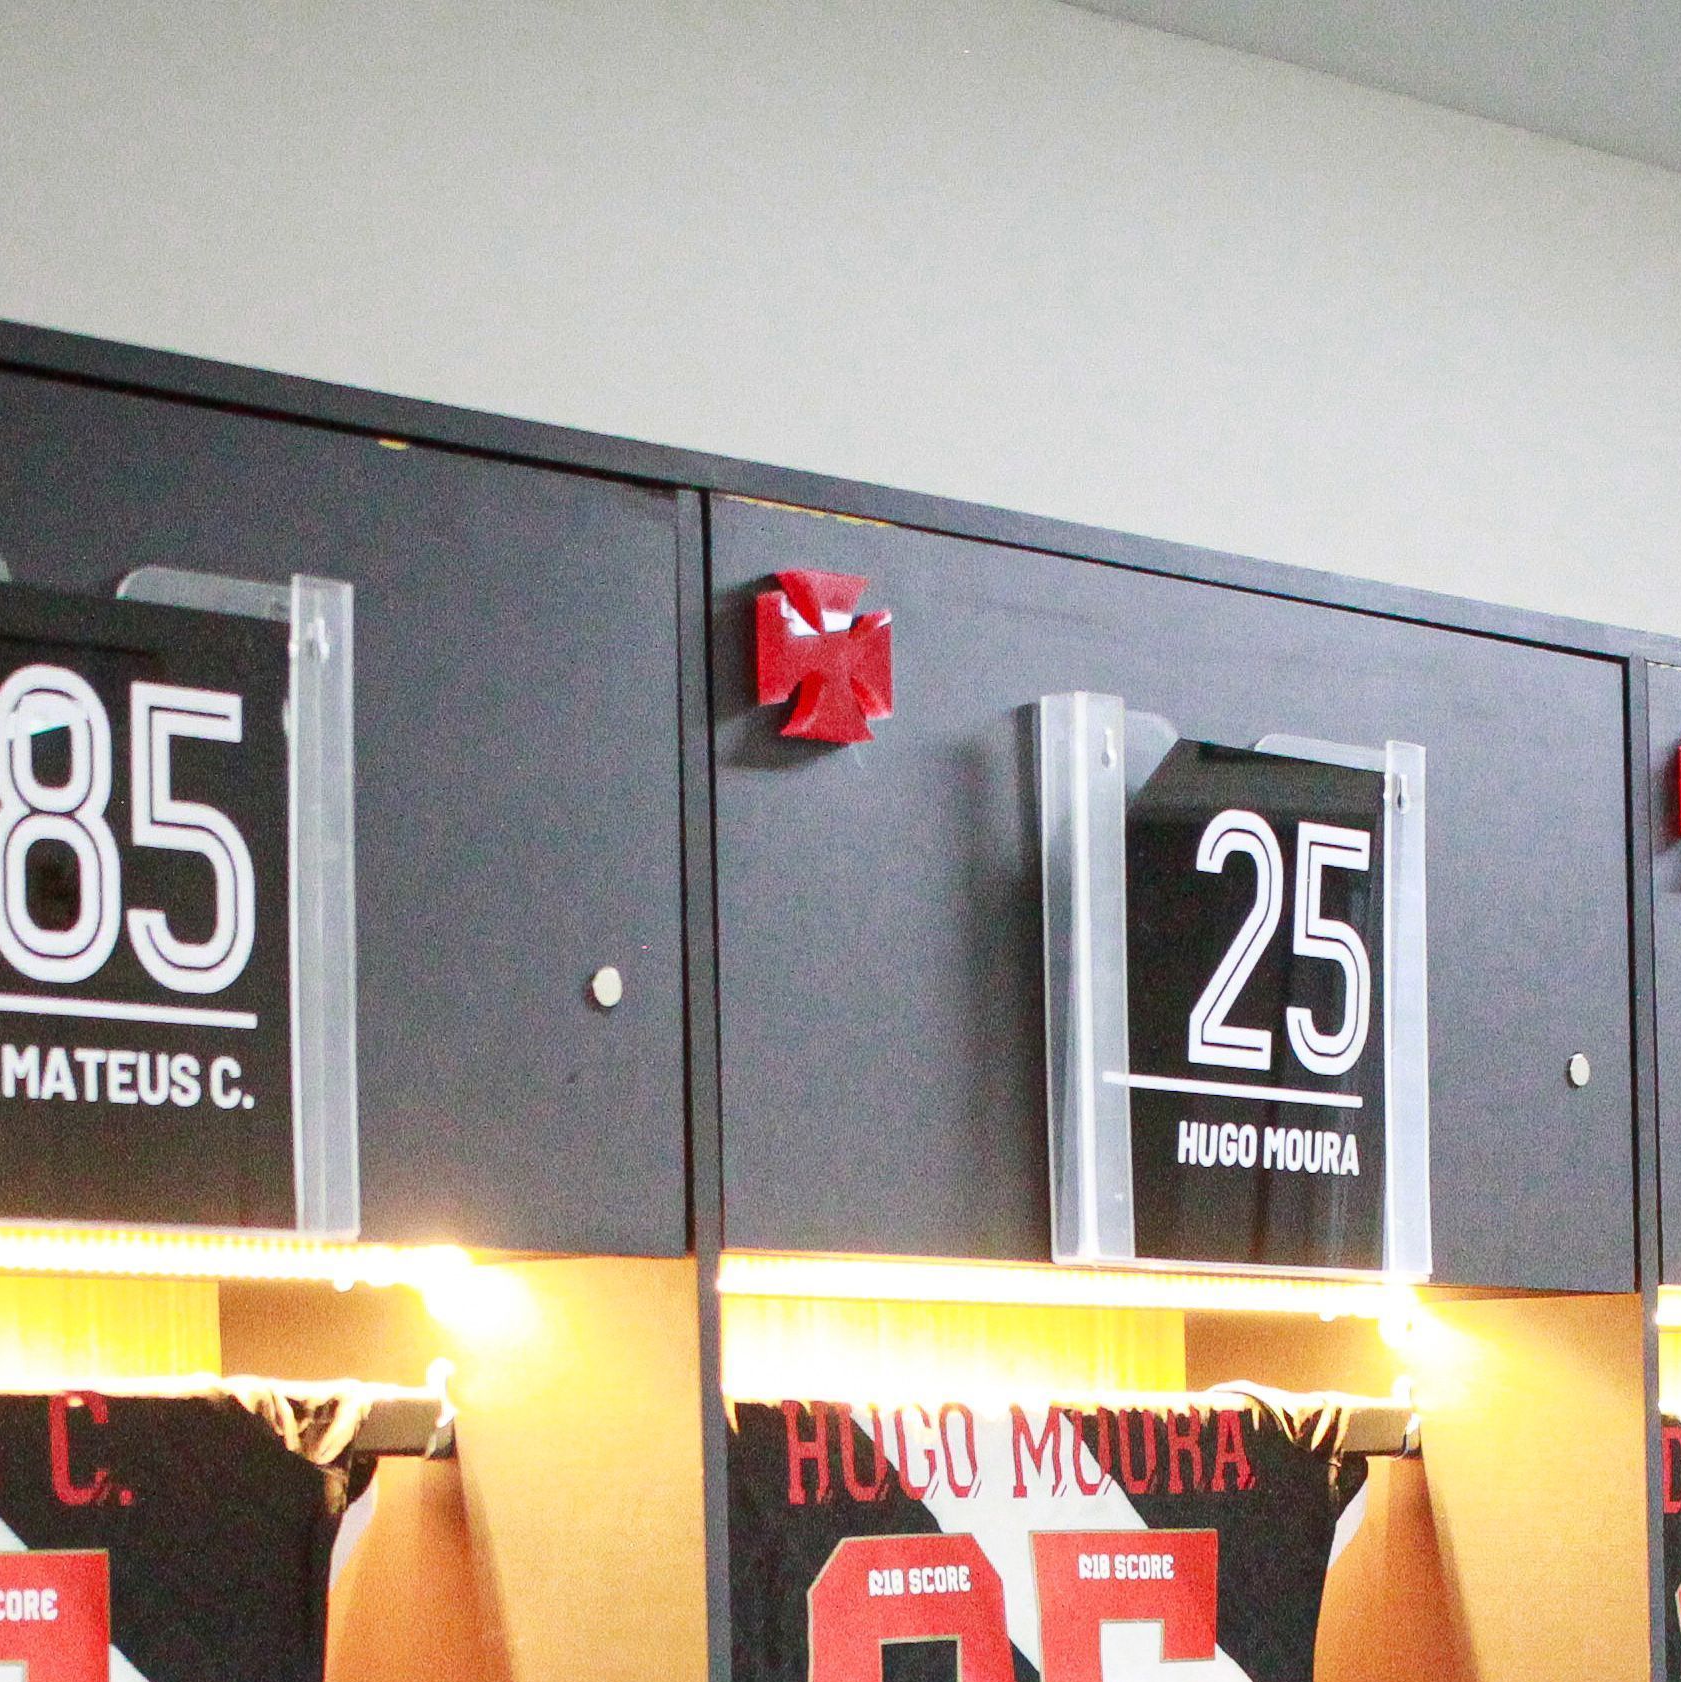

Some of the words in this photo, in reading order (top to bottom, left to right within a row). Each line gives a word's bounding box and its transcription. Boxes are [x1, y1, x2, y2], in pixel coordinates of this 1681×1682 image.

[1188, 809, 1371, 1077] 25
[1, 1043, 202, 1107] MATEUS
[209, 1058, 256, 1110] C.
[1177, 1120, 1257, 1170] HUGO
[1263, 1127, 1360, 1177] MOURA
[48, 1390, 134, 1507] C.
[780, 1400, 984, 1506] HUGO
[1009, 1401, 1258, 1499] MOURA
[908, 1565, 972, 1595] SCORE
[1114, 1553, 1175, 1580] SCORE
